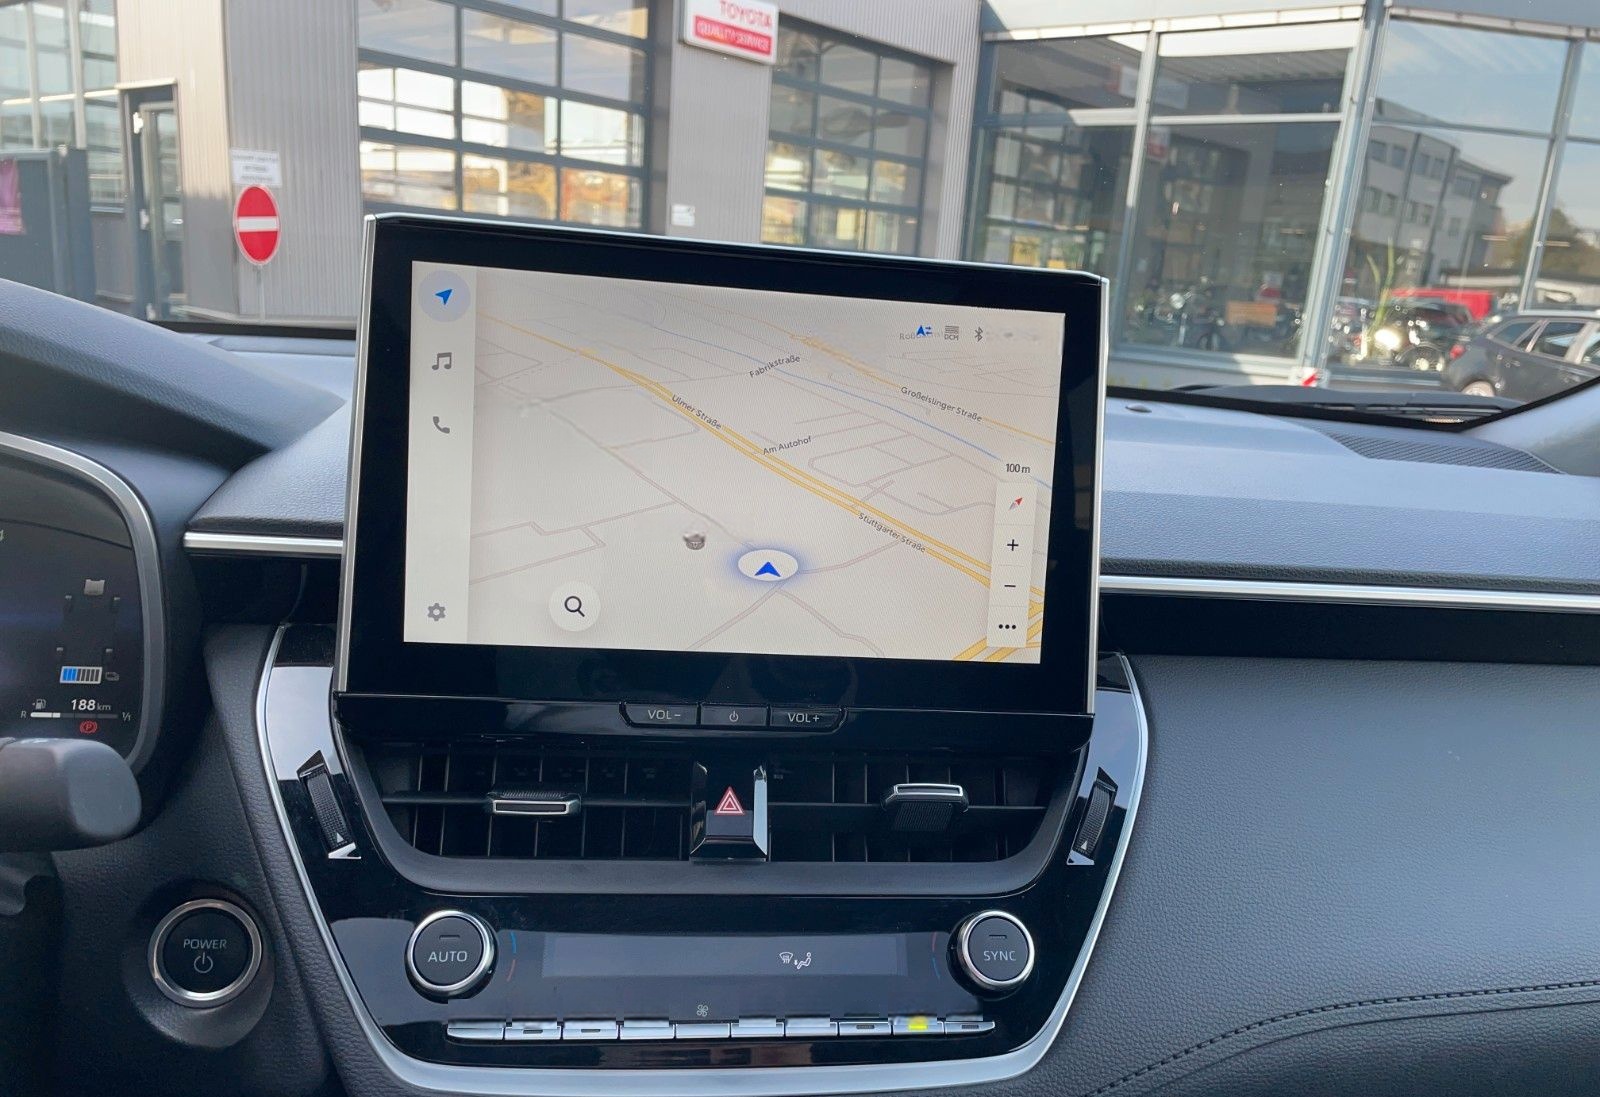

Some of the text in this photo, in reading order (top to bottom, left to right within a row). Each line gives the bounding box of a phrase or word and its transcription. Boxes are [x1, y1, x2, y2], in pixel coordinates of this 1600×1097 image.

[719, 0, 773, 28] TOYOTA
[944, 333, 959, 341] DCM
[749, 354, 801, 378] Fabrikstraße
[671, 394, 722, 430] Ulmer Straße
[956, 407, 983, 422] Straße
[763, 435, 812, 455] Am Autohof
[1005, 463, 1020, 473] 100
[858, 512, 926, 552] Stuttgarter Straße
[71, 699, 96, 711] 188
[183, 939, 227, 949] POWER
[428, 950, 468, 963] AUTO
[983, 950, 1016, 961] SYNC
